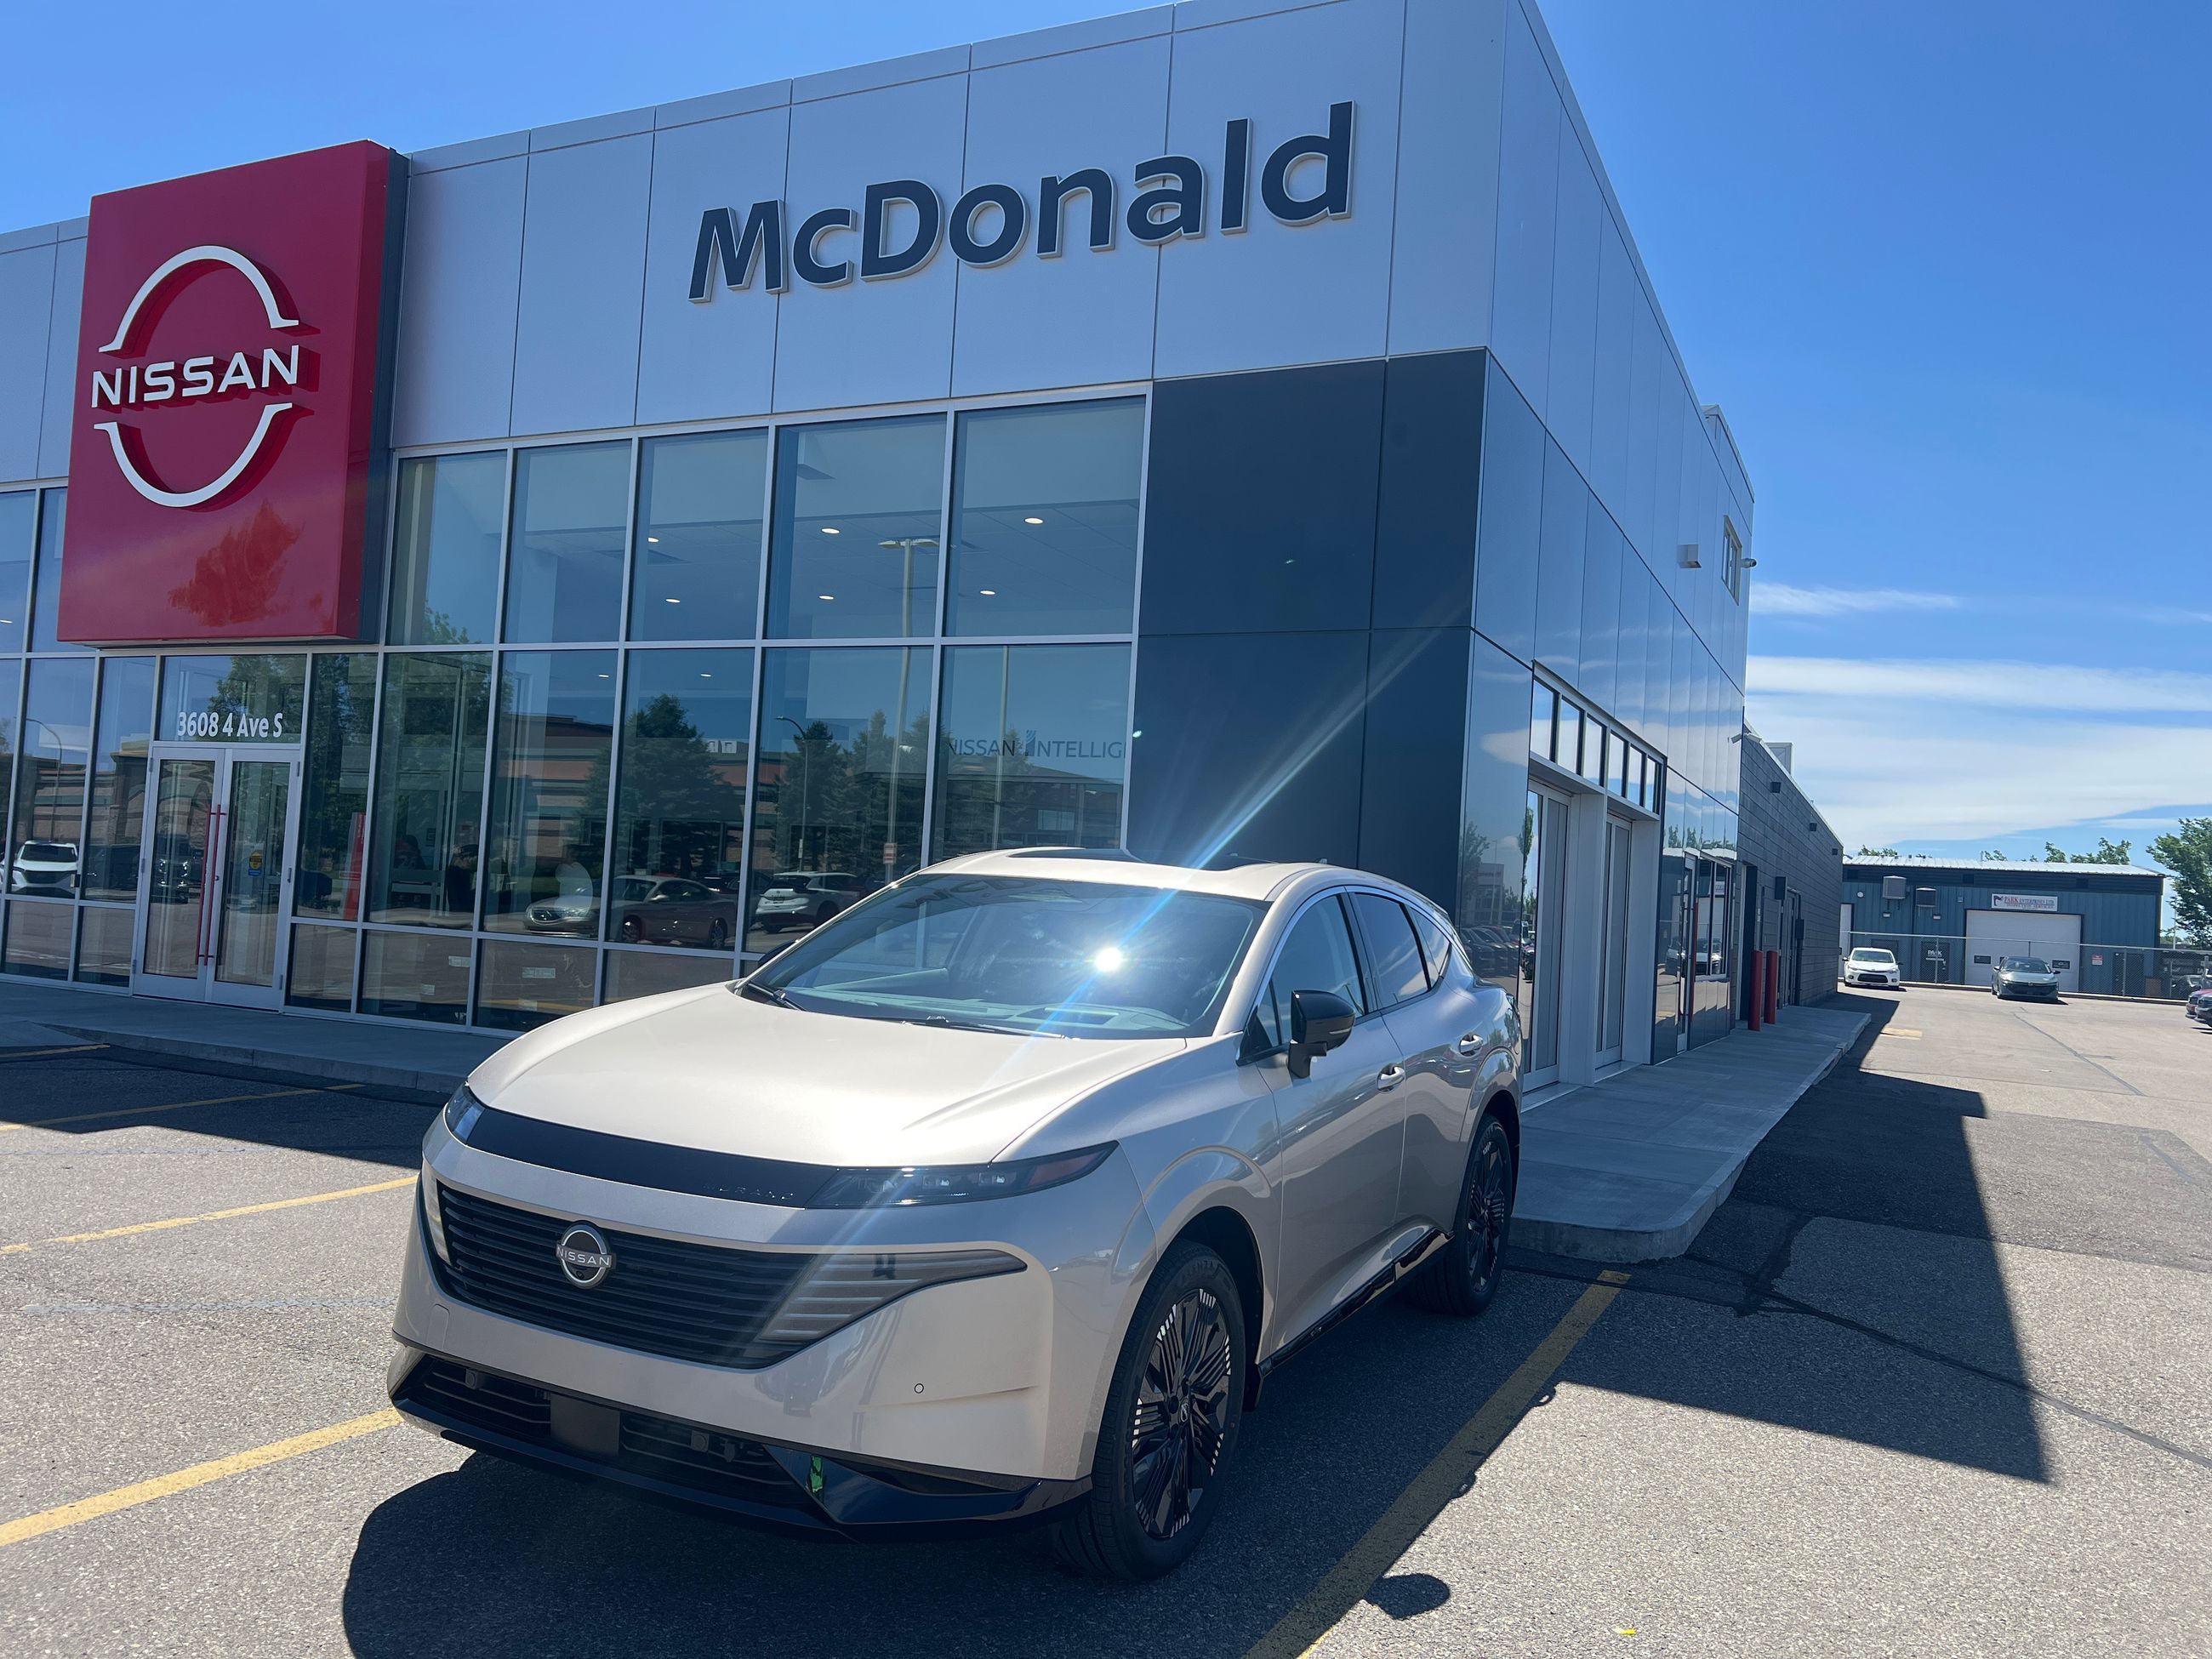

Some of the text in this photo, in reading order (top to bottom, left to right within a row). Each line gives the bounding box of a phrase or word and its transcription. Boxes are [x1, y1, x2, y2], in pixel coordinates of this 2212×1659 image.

[687, 100, 1356, 304] McDonald
[91, 345, 299, 408] NISSAN
[177, 711, 283, 738] 3608 4 Ave S
[949, 729, 1126, 759] NISSAN INTELLIG
[556, 1246, 610, 1266] NISSAN
